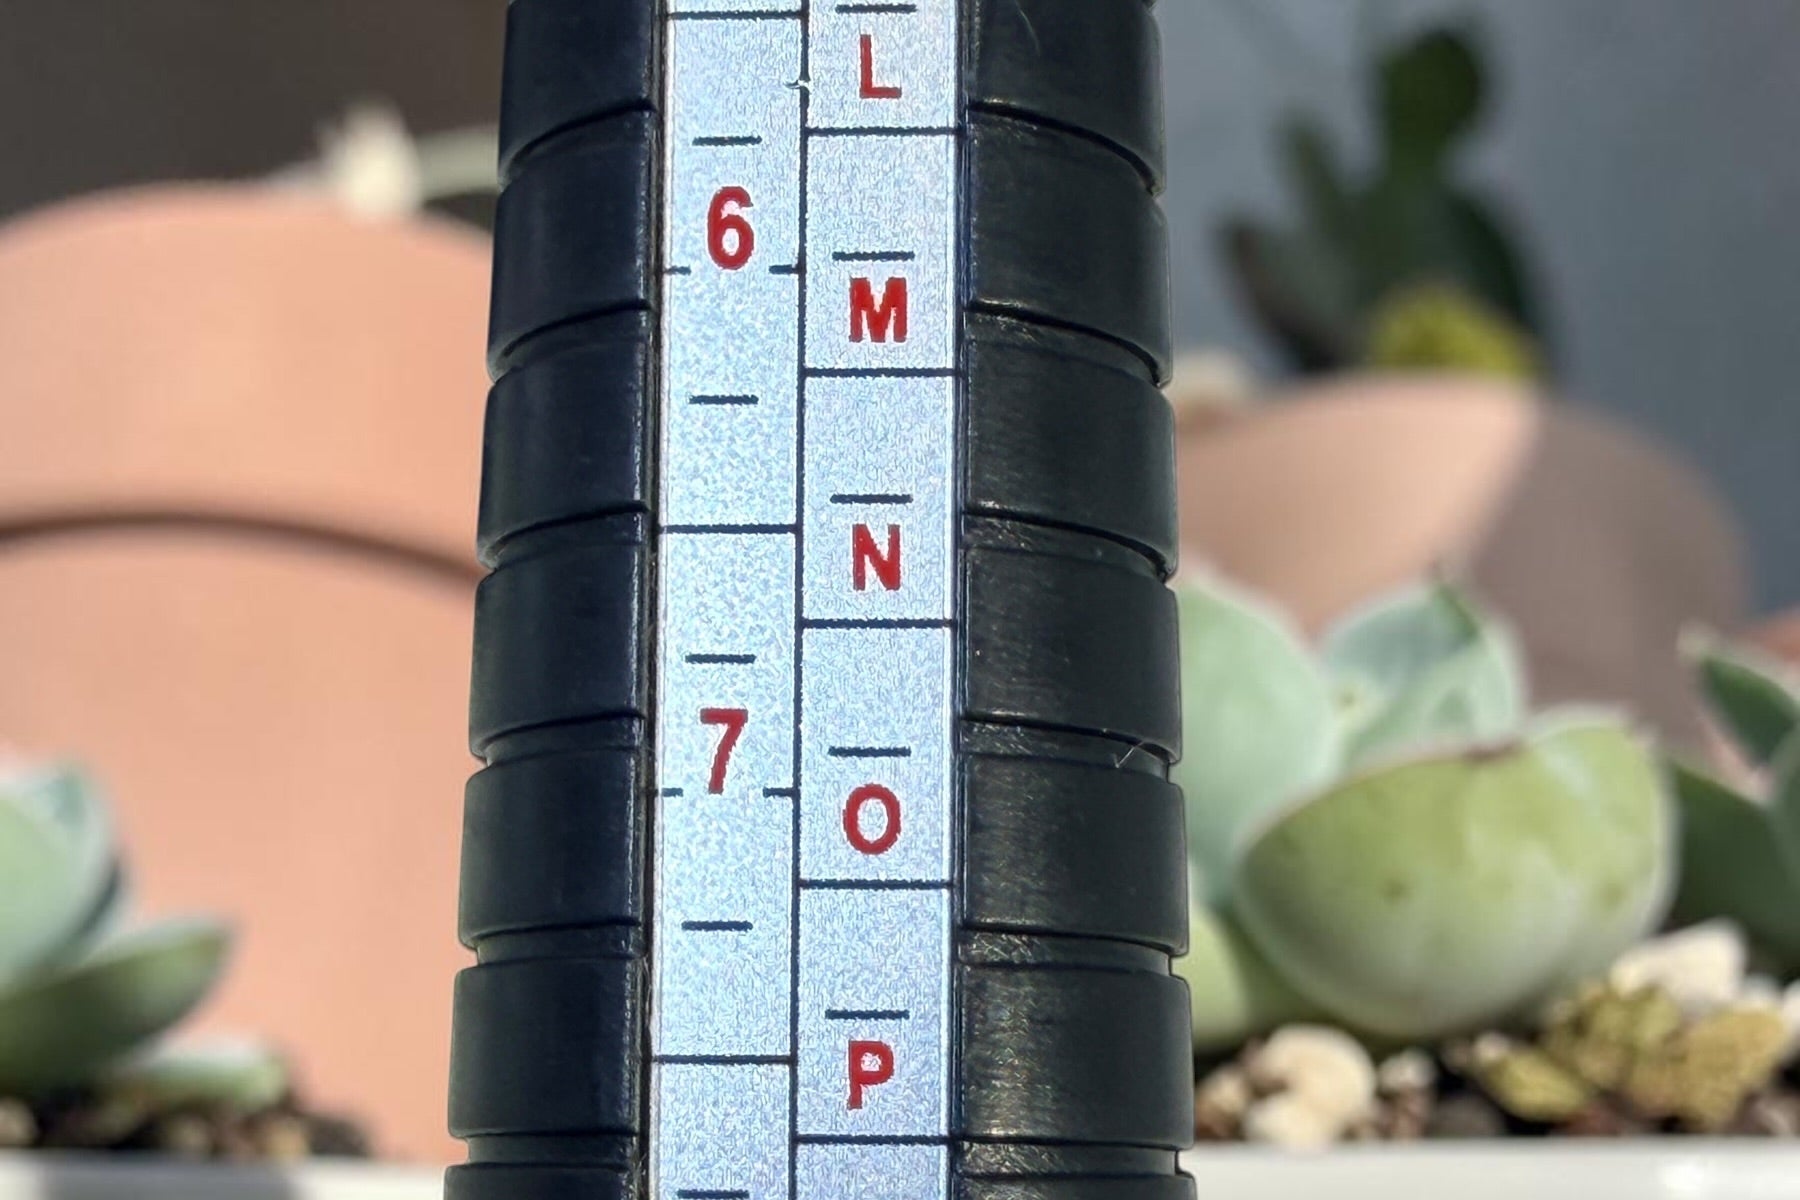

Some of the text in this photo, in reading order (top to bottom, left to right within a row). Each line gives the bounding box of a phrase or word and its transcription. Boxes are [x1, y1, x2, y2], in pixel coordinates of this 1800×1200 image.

[860, 34, 902, 99] L
[707, 186, 755, 270] 6
[849, 276, 909, 342] M
[853, 524, 902, 590] N
[700, 708, 748, 793] 7
[842, 783, 901, 854] O
[847, 1040, 894, 1109] P
